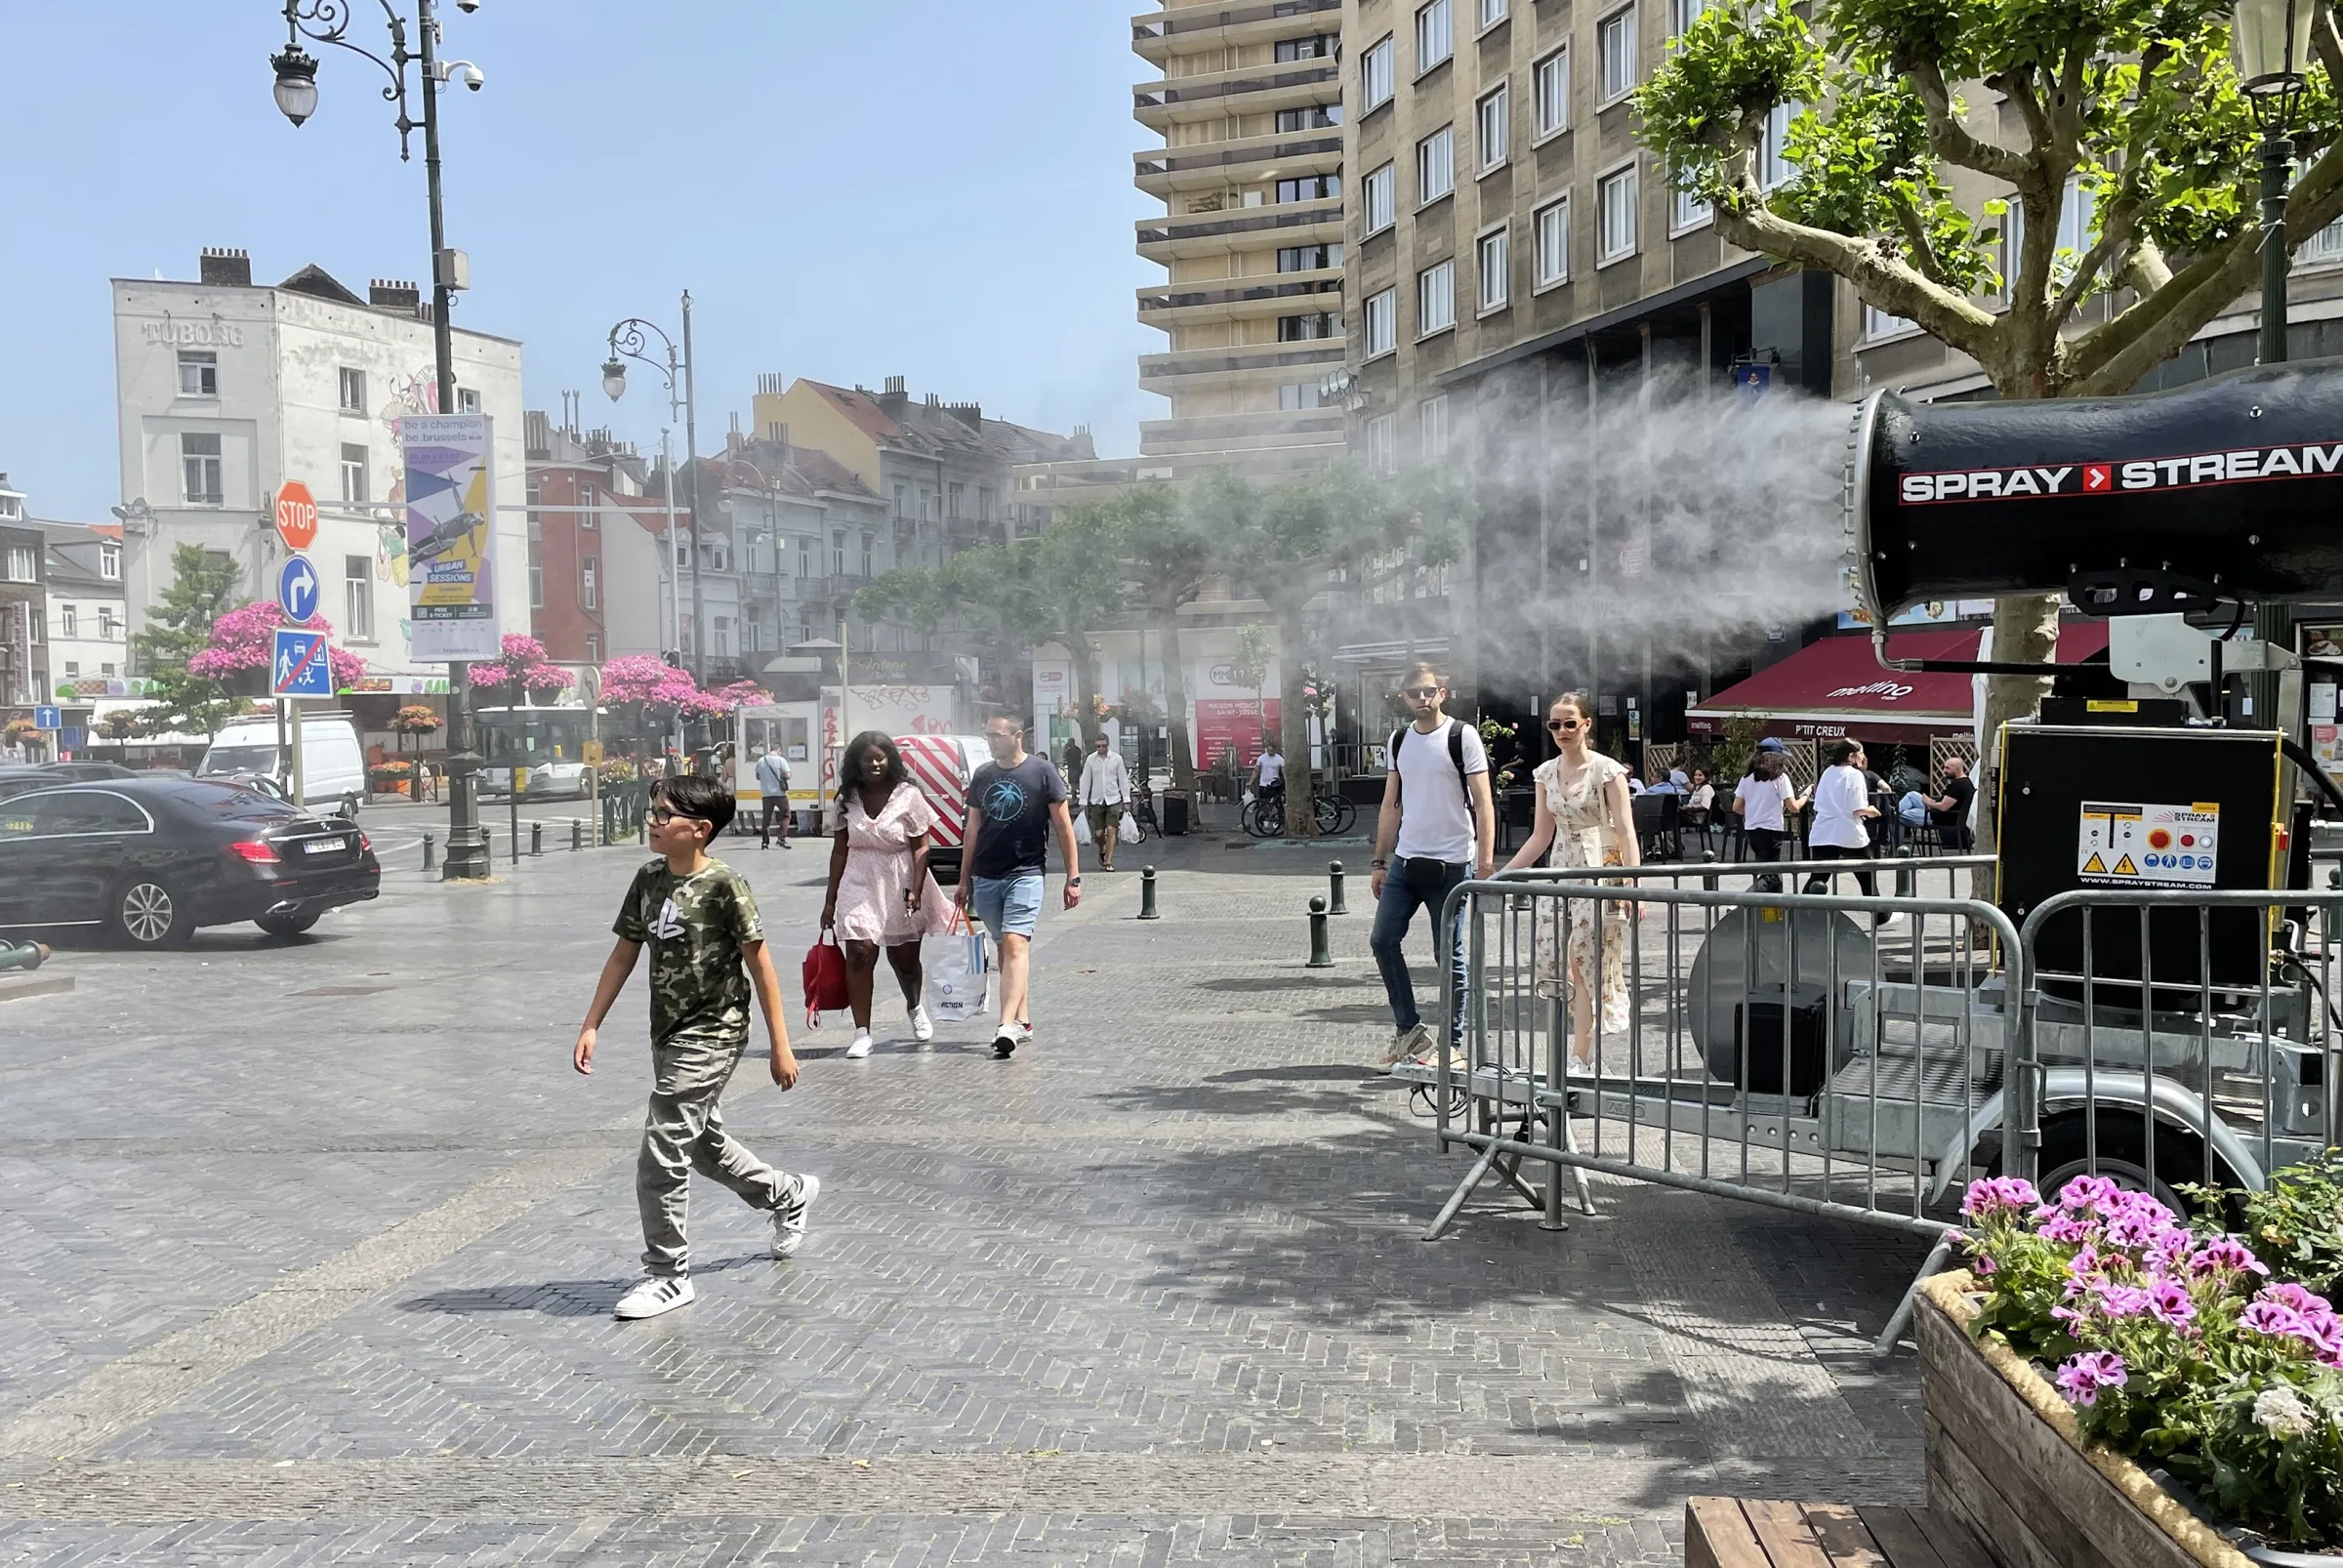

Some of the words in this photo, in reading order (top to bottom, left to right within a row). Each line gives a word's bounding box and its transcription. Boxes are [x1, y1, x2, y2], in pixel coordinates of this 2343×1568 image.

[143, 321, 244, 346] TUBORG
[430, 419, 482, 430] champion
[1902, 467, 2073, 503] SPRAY
[2121, 444, 2343, 490] STREAM
[279, 499, 315, 531] STOP
[433, 560, 464, 573] URBAN
[430, 573, 472, 583] SESSIONS
[1826, 680, 1913, 697] meltino
[1795, 724, 1816, 736] P'TIT
[1816, 724, 1846, 737] CREUX
[2080, 877, 2212, 890] WWW.SPRAYSTREAM.COM
